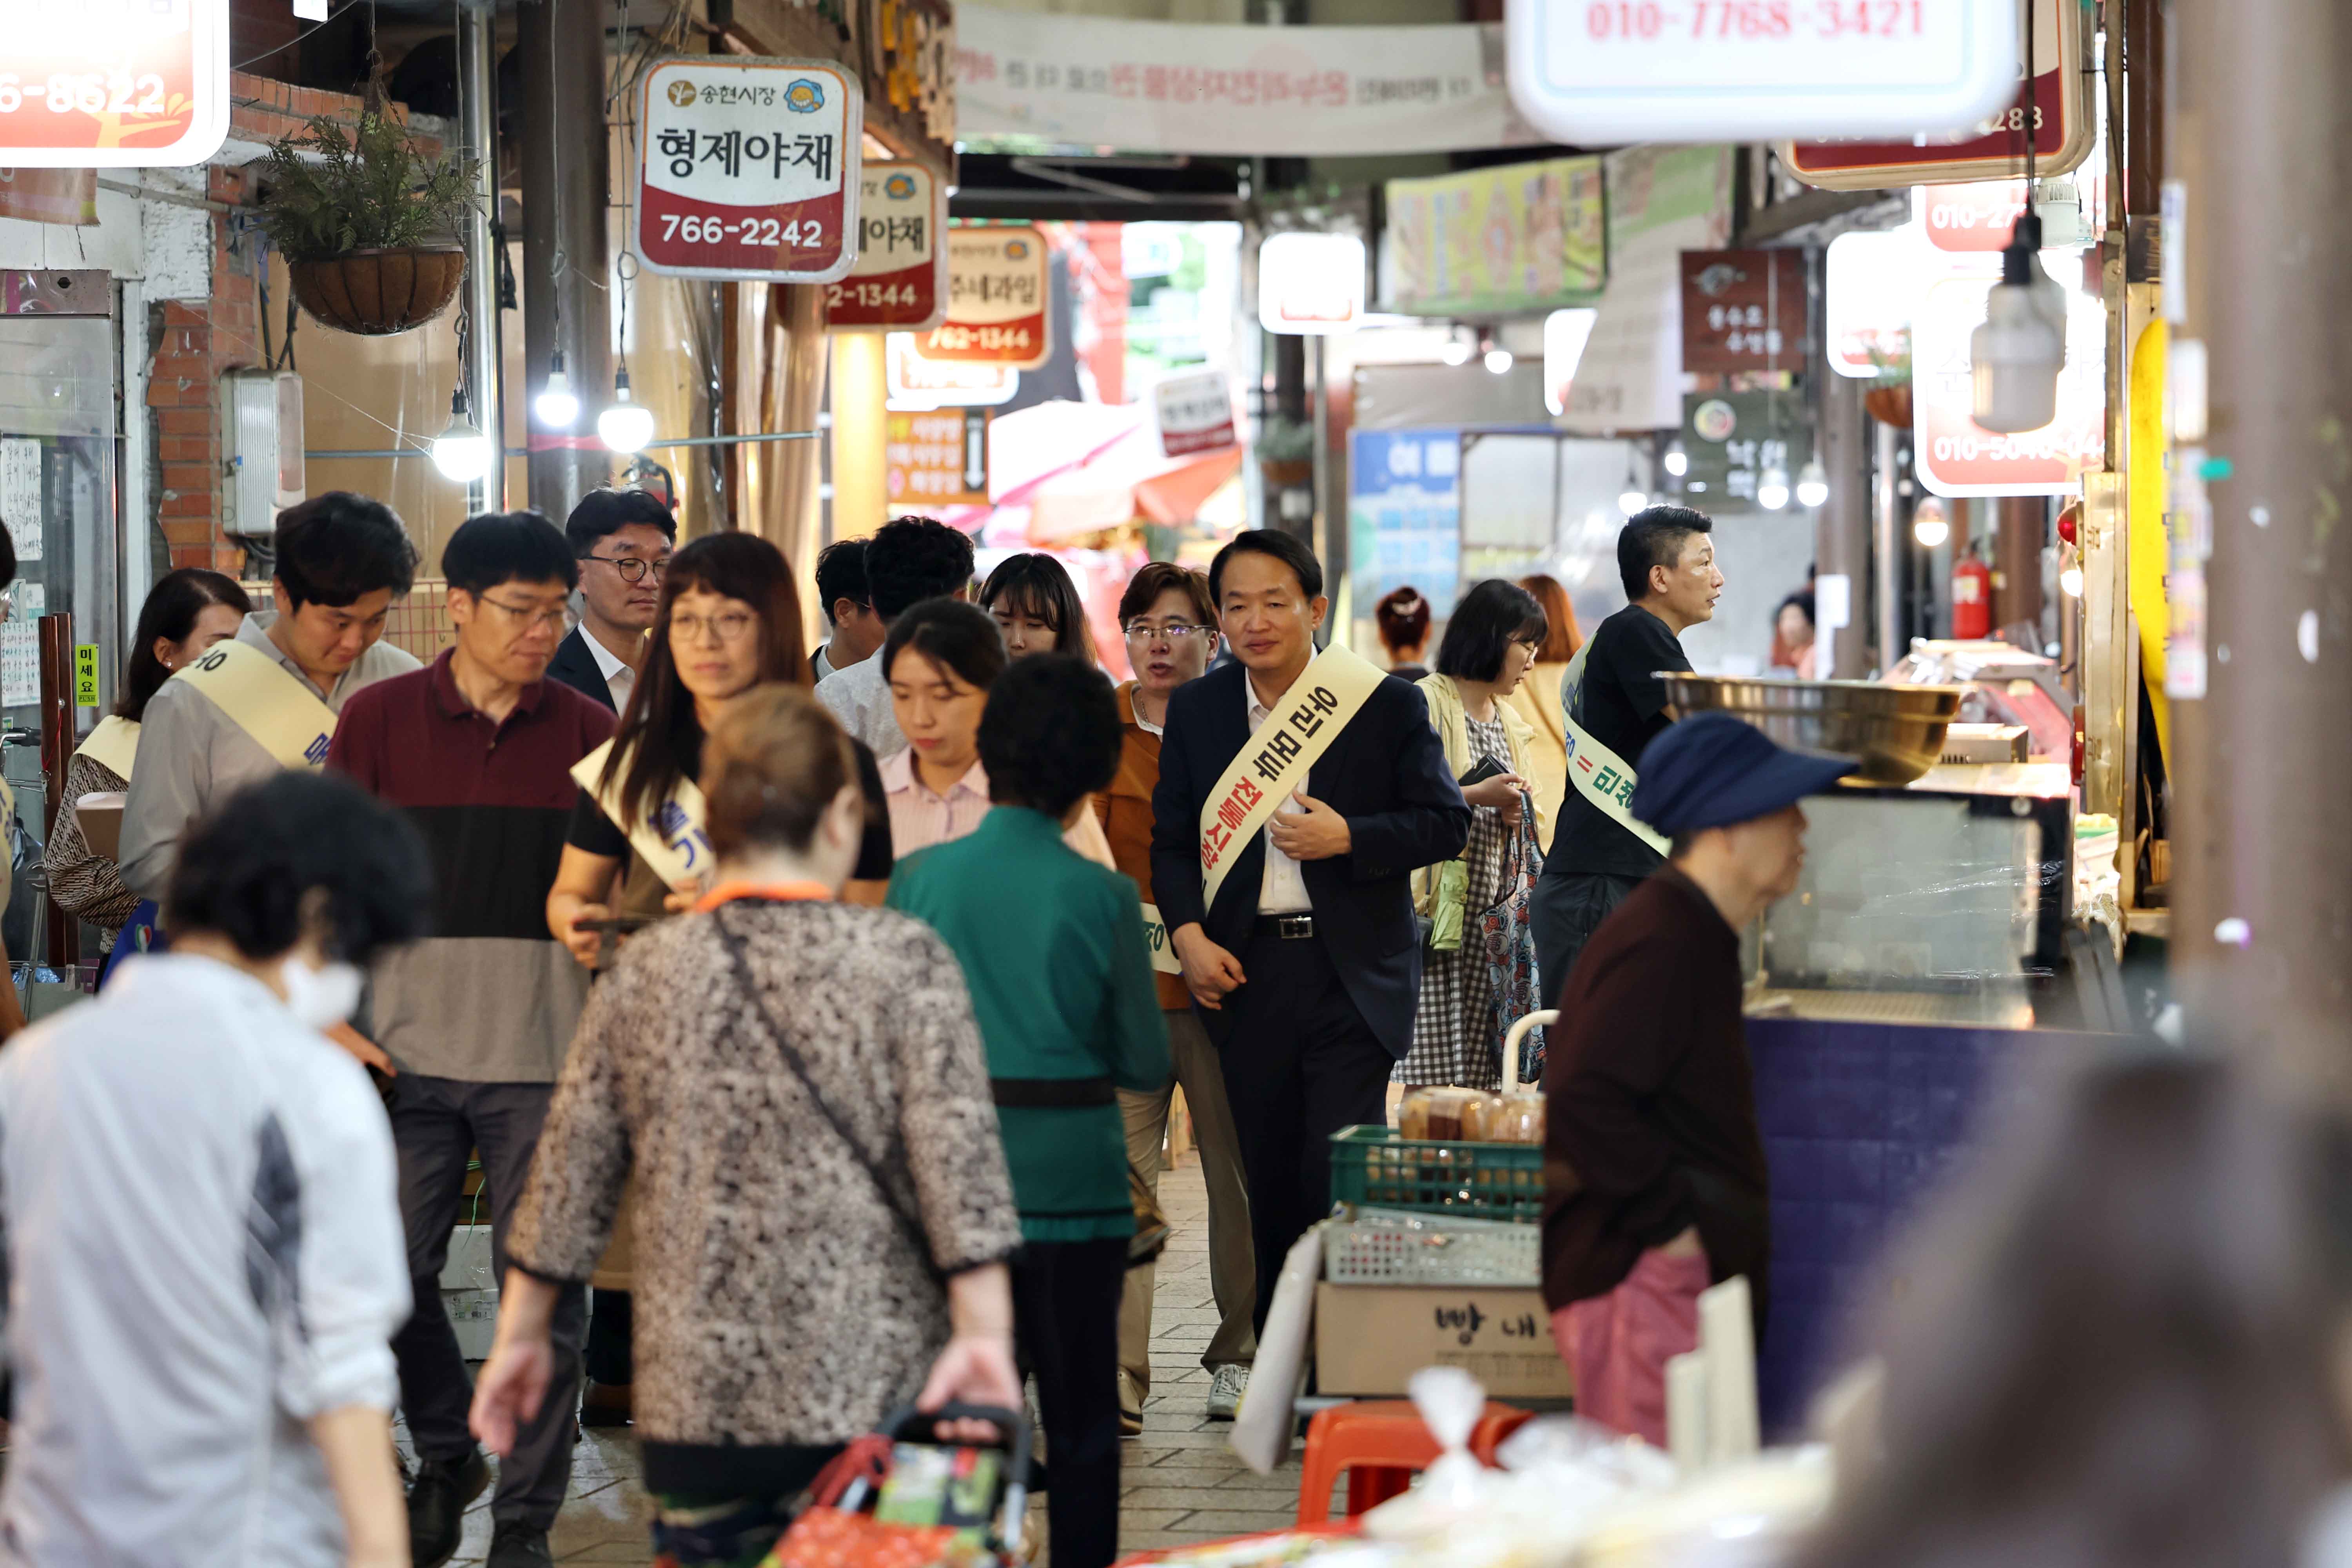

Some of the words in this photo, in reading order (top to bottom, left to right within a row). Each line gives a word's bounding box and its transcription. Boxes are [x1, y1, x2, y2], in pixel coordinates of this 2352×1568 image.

[700, 85, 776, 106] 송현시장
[657, 129, 833, 181] 형제야채
[660, 214, 822, 247] 766-2242
[1935, 434, 2105, 461] 010-5040-04
[80, 648, 93, 692] 미세요
[1289, 686, 1338, 739] 우리
[1252, 729, 1302, 782] 모두
[1201, 775, 1263, 870] 전통시장
[1501, 1312, 1536, 1338] 내
